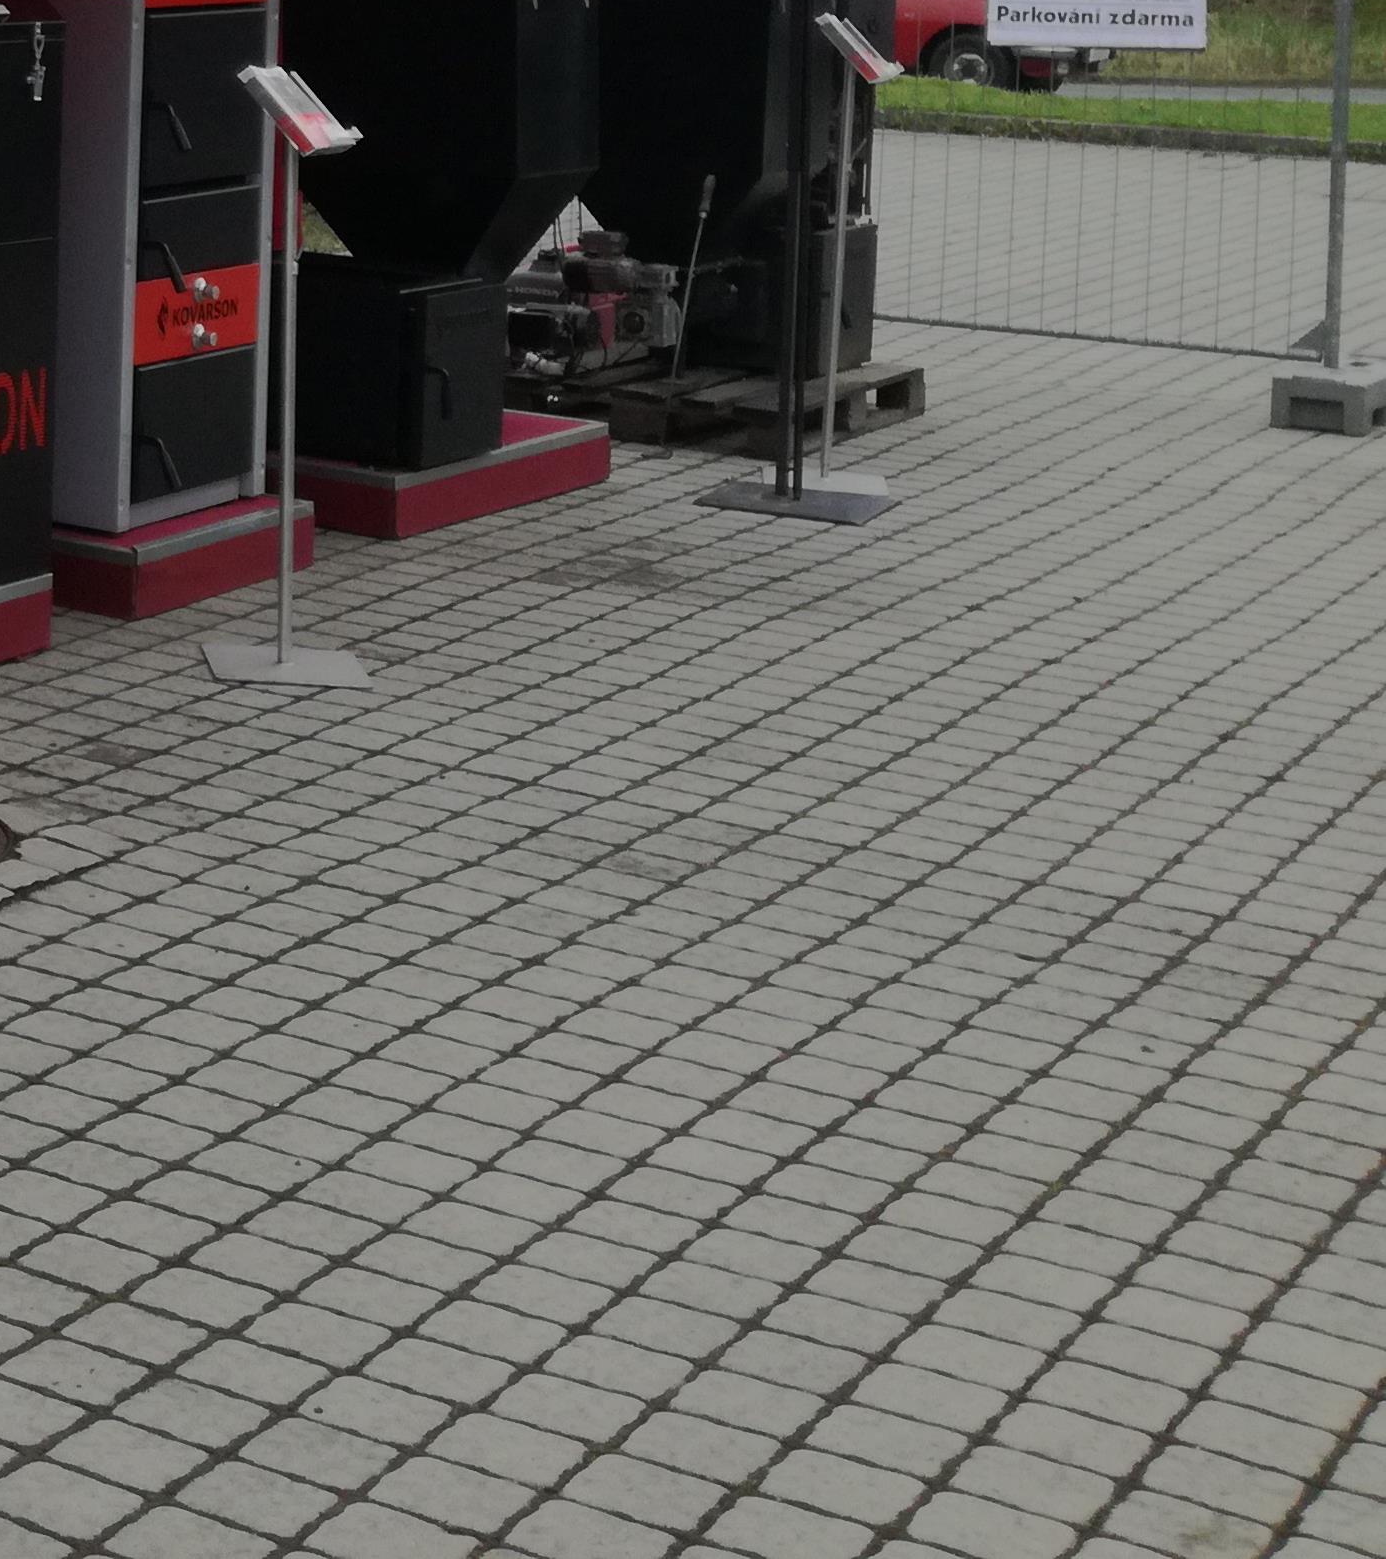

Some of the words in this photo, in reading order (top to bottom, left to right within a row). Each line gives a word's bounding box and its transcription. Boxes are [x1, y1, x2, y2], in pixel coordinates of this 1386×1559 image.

[996, 5, 1101, 25] Parkování
[1109, 9, 1195, 27] zdarma
[172, 298, 239, 327] KOVARSON
